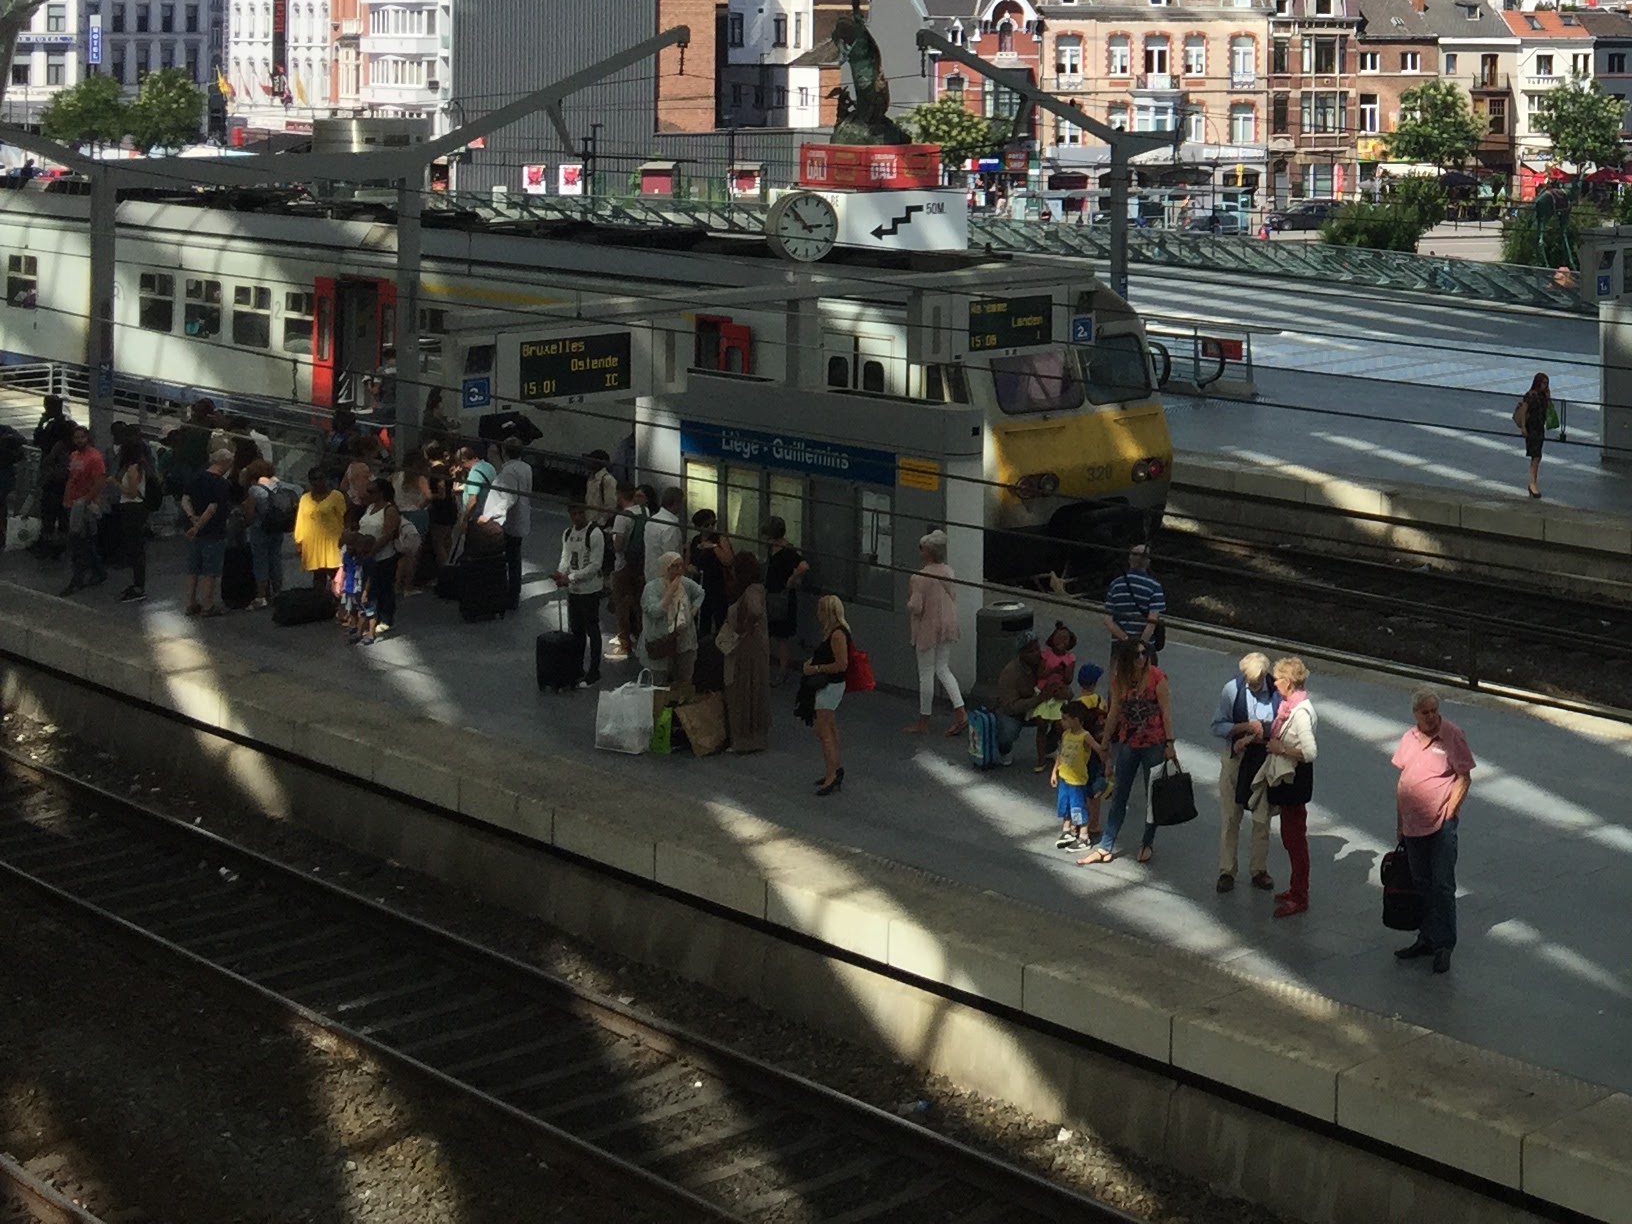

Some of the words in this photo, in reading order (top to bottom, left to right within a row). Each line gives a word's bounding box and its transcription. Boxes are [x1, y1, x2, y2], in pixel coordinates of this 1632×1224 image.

[274, 299, 282, 320] 2
[522, 339, 585, 357] Bruxelles
[570, 355, 619, 371] Ostende
[605, 373, 619, 387] IC
[721, 429, 759, 459] Liège
[772, 437, 850, 470] Guillemins
